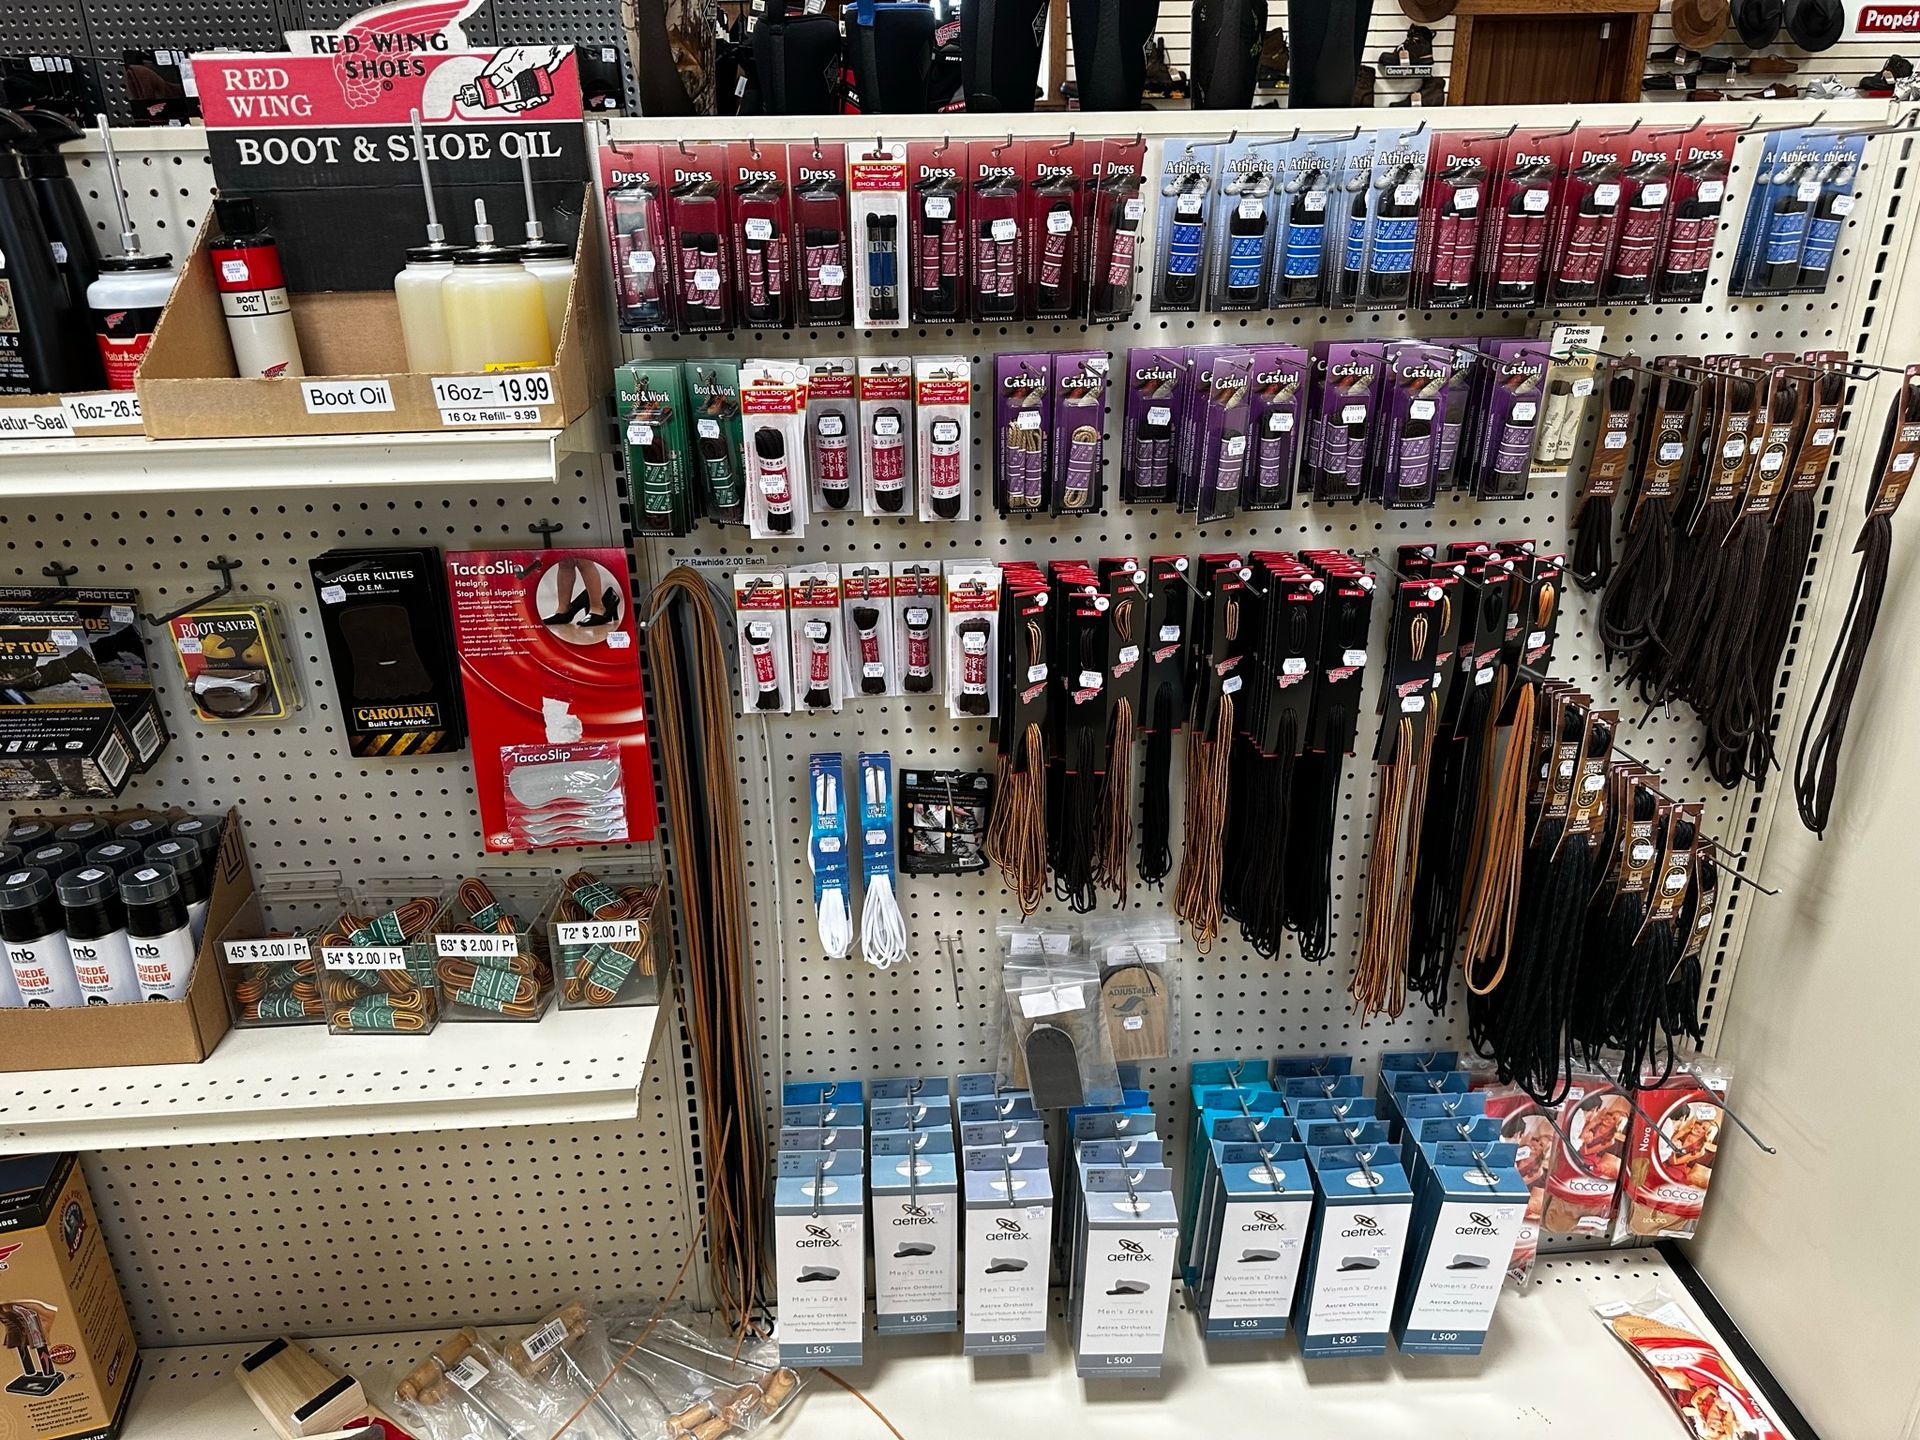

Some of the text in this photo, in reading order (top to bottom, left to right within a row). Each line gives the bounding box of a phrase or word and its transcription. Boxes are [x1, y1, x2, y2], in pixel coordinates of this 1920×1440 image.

[1865, 10, 1920, 30] Propét
[310, 32, 449, 54] RED WING
[345, 59, 426, 79] SHOES
[222, 68, 289, 92] RED
[226, 95, 313, 118] WING
[236, 131, 563, 166] BOOT & SHOE OIL
[1688, 148, 1724, 160] Dress
[1378, 152, 1426, 166] Athletic
[1446, 155, 1481, 167] Dress
[1516, 153, 1550, 166] Dress
[1582, 152, 1616, 165] Dress
[1631, 151, 1666, 163] Dress
[1779, 151, 1819, 163] Athletic
[980, 164, 1015, 177] Dress
[1038, 164, 1073, 177] Dress
[1107, 162, 1135, 175] Dress
[1165, 162, 1211, 174] Athletic
[1227, 161, 1273, 173] Athletic
[1288, 158, 1330, 171] Athletic
[612, 170, 649, 183] Dress
[675, 170, 712, 182] Dress
[740, 168, 777, 181] Dress
[800, 168, 836, 180] Dress
[920, 166, 956, 178] Dress
[236, 295, 260, 304] BOOT
[242, 304, 258, 312] OIL
[1565, 328, 1590, 336] Dress
[1136, 366, 1177, 380] Casual
[1332, 362, 1374, 377] Casual
[1403, 363, 1446, 378] Casual
[1501, 362, 1542, 377] Casual
[1004, 373, 1045, 388] Casual
[1062, 373, 1101, 388] Casual
[1215, 373, 1247, 390] Casual
[1256, 370, 1299, 385] Casual
[311, 387, 387, 406] Boot Oil
[500, 378, 549, 402] 19.99
[621, 391, 670, 402] Boot & Work
[694, 384, 735, 396] Boot & Work
[448, 413, 460, 422] 16
[463, 413, 476, 422] Oz
[515, 411, 537, 420] 9.99
[374, 571, 415, 580] KILTIES
[358, 584, 385, 592] O.E.M.
[455, 580, 488, 588] Heelgrip
[78, 591, 131, 599] PROTECT
[457, 590, 474, 598] Stop
[494, 589, 527, 597] slipping!
[19, 615, 75, 623] PROTECT
[180, 620, 256, 638] BOOT SAVER
[19, 641, 60, 653] TOE
[358, 706, 435, 721] CAROLINA
[513, 749, 571, 763] TaccoSlip
[562, 926, 637, 940] 72" $ 2.00 Pr
[73, 946, 96, 959] mb
[135, 944, 159, 957] mb
[230, 942, 307, 959] 45" $ 2.00 Pr
[440, 939, 515, 953] 63" $ 2.00 Pr
[11, 949, 35, 961] mb
[327, 950, 402, 965] 54" $ 2.00 Pr
[15, 968, 45, 978] SUEDE
[76, 966, 106, 976] SUEDE
[137, 963, 168, 974] SUEDE
[17, 977, 49, 988] RENEW
[78, 974, 110, 985] RENEW
[139, 972, 172, 983] RENEW
[1639, 1127, 1651, 1152] Nova
[1569, 1179, 1609, 1192] tacco
[1657, 1186, 1699, 1201] tacco
[892, 1216, 935, 1226] aetrex
[1242, 1223, 1285, 1232] aetrex
[986, 1231, 1029, 1241] aetrex
[1341, 1228, 1384, 1238] aetrex
[1455, 1226, 1498, 1236] aetrex
[796, 1239, 840, 1248] aetrex
[1107, 1252, 1152, 1262] aetrex
